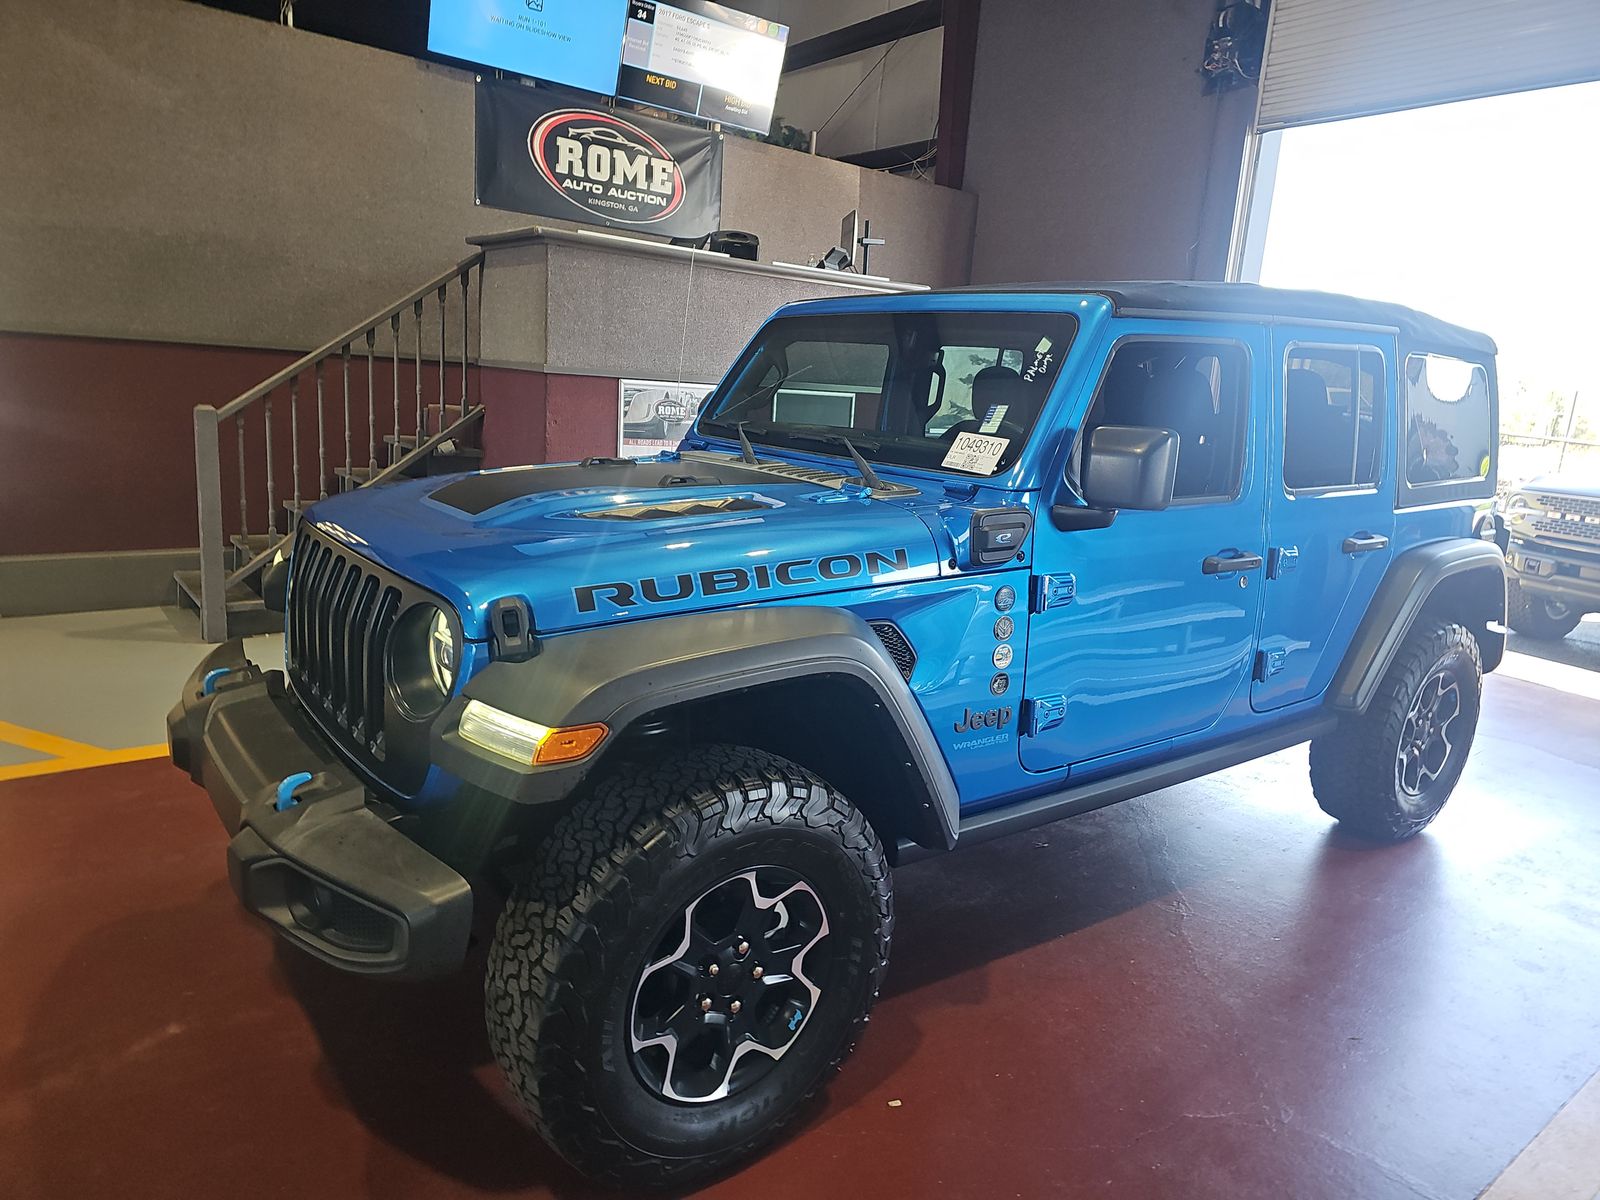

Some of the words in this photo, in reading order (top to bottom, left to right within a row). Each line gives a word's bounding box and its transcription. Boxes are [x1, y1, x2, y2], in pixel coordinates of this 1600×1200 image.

[636, 9, 647, 20] 34
[658, 8, 672, 18] 2017
[672, 12, 686, 23] FORD
[686, 15, 707, 29] ESCAPE
[490, 15, 514, 28] WAITING
[515, 22, 525, 30] ON
[525, 24, 557, 39] SLIDESHOW
[557, 33, 572, 42] VIEW
[646, 74, 665, 86] NEXT
[665, 79, 677, 90] BID
[555, 136, 674, 195] ROME
[562, 178, 604, 194] AUTO
[607, 187, 668, 207] AUCTION
[588, 197, 627, 211] KINGSTON,
[628, 204, 639, 213] GA
[657, 405, 686, 415] ROME
[955, 437, 1003, 456] 1049310
[574, 548, 909, 613] RUBICON
[954, 706, 1013, 734] Jeep
[952, 733, 1009, 750] WRANGLER
